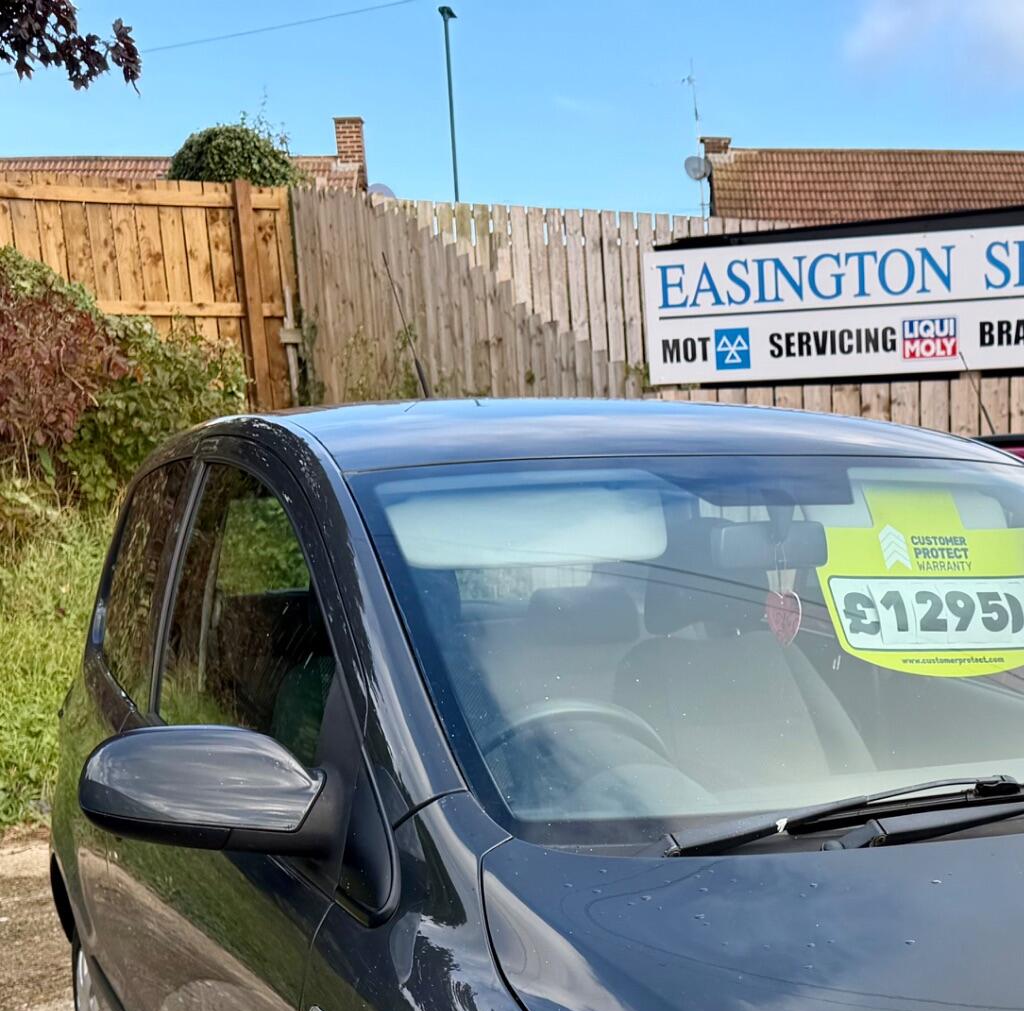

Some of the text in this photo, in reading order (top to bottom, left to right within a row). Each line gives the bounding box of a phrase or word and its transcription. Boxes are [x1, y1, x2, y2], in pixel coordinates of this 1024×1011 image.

[657, 245, 955, 309] EASINGTON
[902, 318, 957, 339] LIQUI
[661, 336, 711, 364] MOT
[768, 326, 898, 359] SERVICING
[902, 336, 959, 359] MOLY
[911, 535, 967, 547] CUSTOMER
[913, 547, 969, 560] PROTECT
[916, 561, 973, 572] WARRANTY
